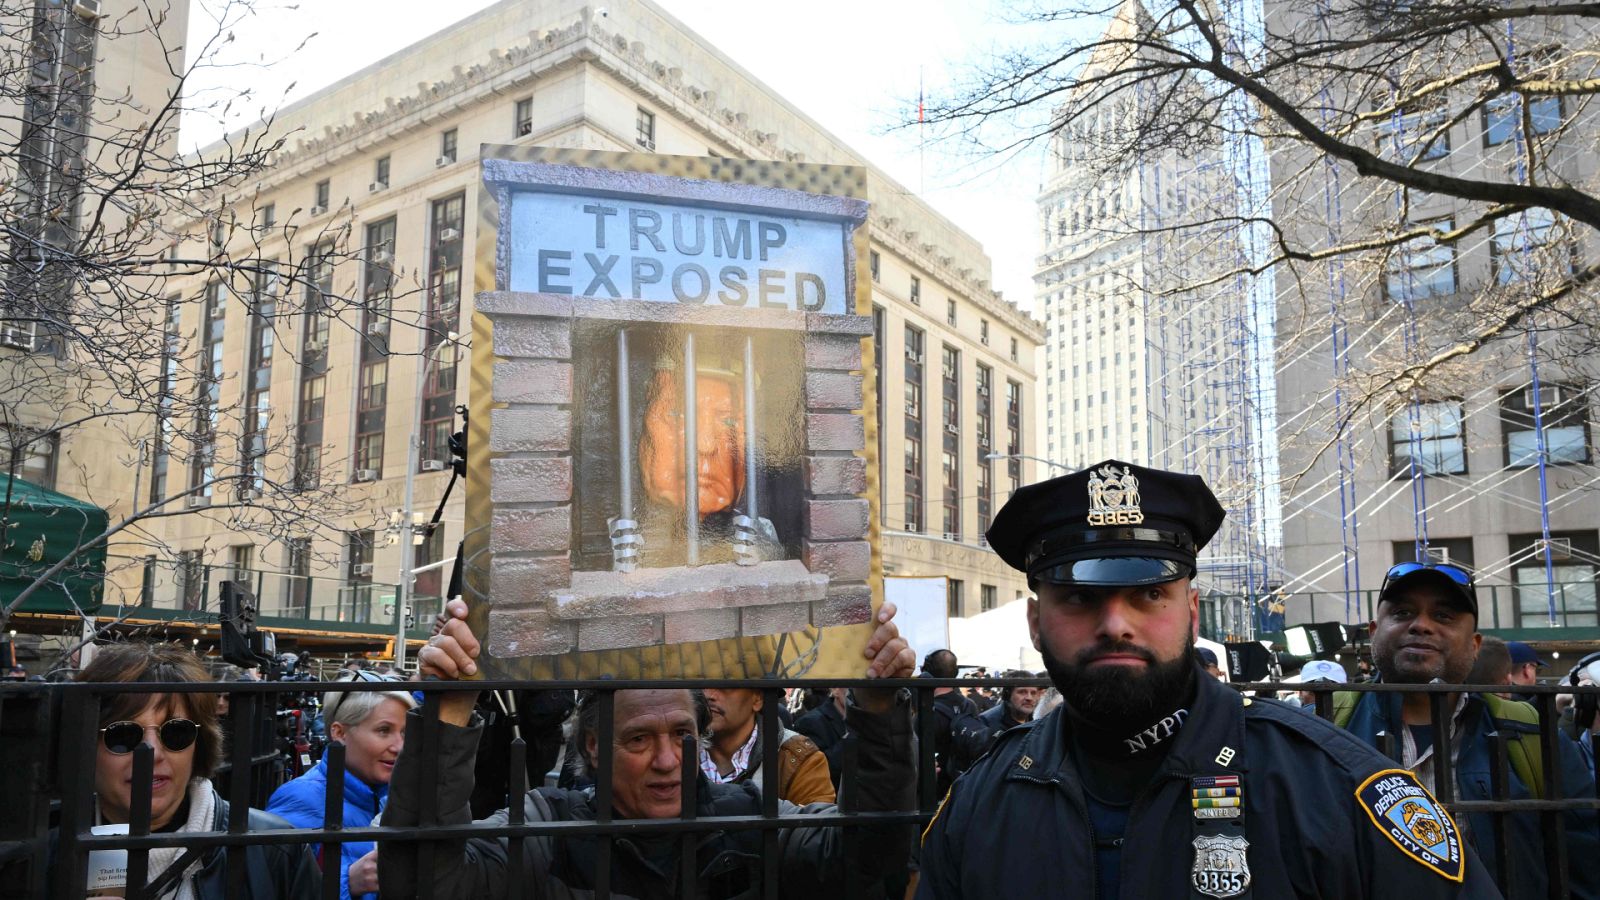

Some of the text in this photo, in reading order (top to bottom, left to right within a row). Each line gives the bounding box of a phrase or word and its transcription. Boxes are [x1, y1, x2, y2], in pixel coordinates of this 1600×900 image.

[583, 203, 787, 262] TRUMP
[537, 248, 827, 313] EXPOSED
[1093, 510, 1140, 525] 9865
[1374, 776, 1408, 796] POLICE
[1206, 808, 1228, 817] NYPD
[1374, 785, 1426, 817] DEPARTMENT
[1391, 803, 1459, 865] CITY OF NEW YORK
[1199, 871, 1242, 892] 9865
